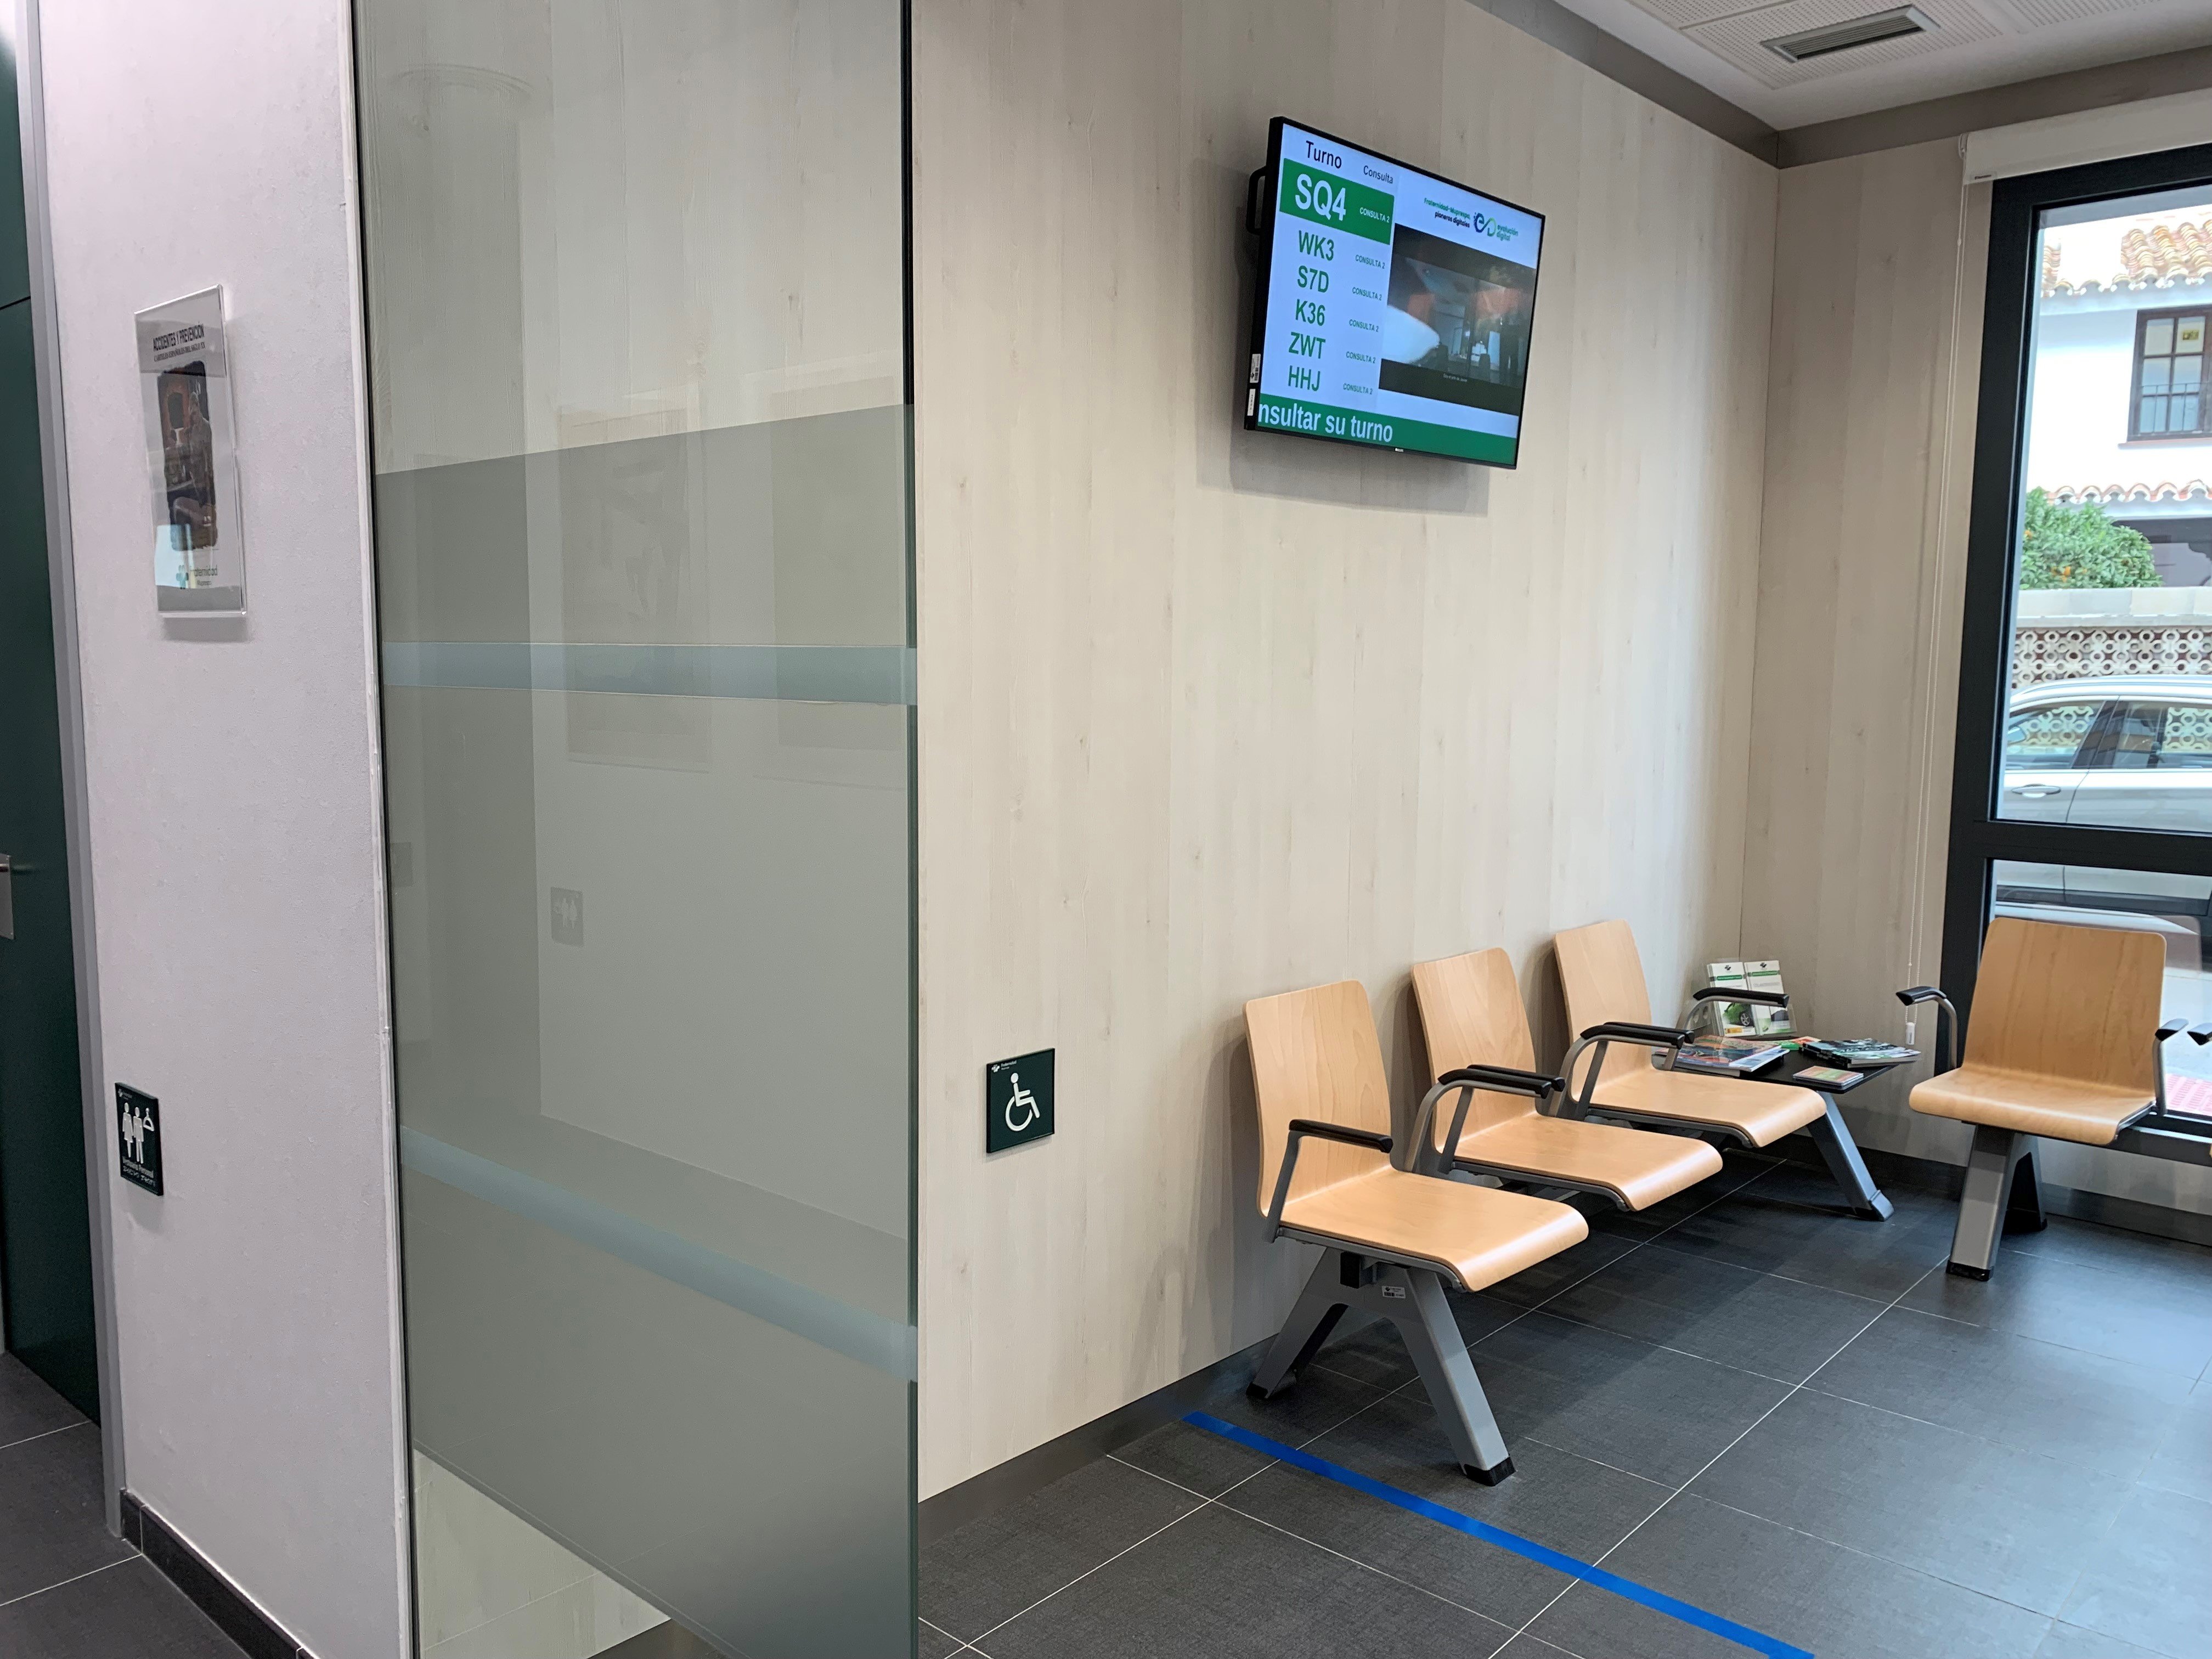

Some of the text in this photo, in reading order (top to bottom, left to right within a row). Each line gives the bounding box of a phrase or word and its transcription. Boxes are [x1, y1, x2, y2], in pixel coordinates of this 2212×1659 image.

[1306, 140, 1342, 169] Turno
[1363, 165, 1393, 184] Consulta
[1295, 173, 1346, 221] SQ4
[1359, 207, 1386, 222] CONSULTA
[1299, 230, 1334, 261] WK3
[1355, 254, 1381, 268] CONSULTA
[1297, 265, 1329, 293] S7D
[1352, 286, 1378, 300] CONSULTA
[1295, 298, 1325, 326] K36
[1348, 319, 1375, 331] CONSULTA
[1288, 331, 1326, 359] ZWT
[1346, 351, 1372, 363] CONSULTA
[1288, 365, 1321, 391] HHJ
[1343, 383, 1369, 394] CONSULTA
[1258, 403, 1393, 443] nsultar su turno
